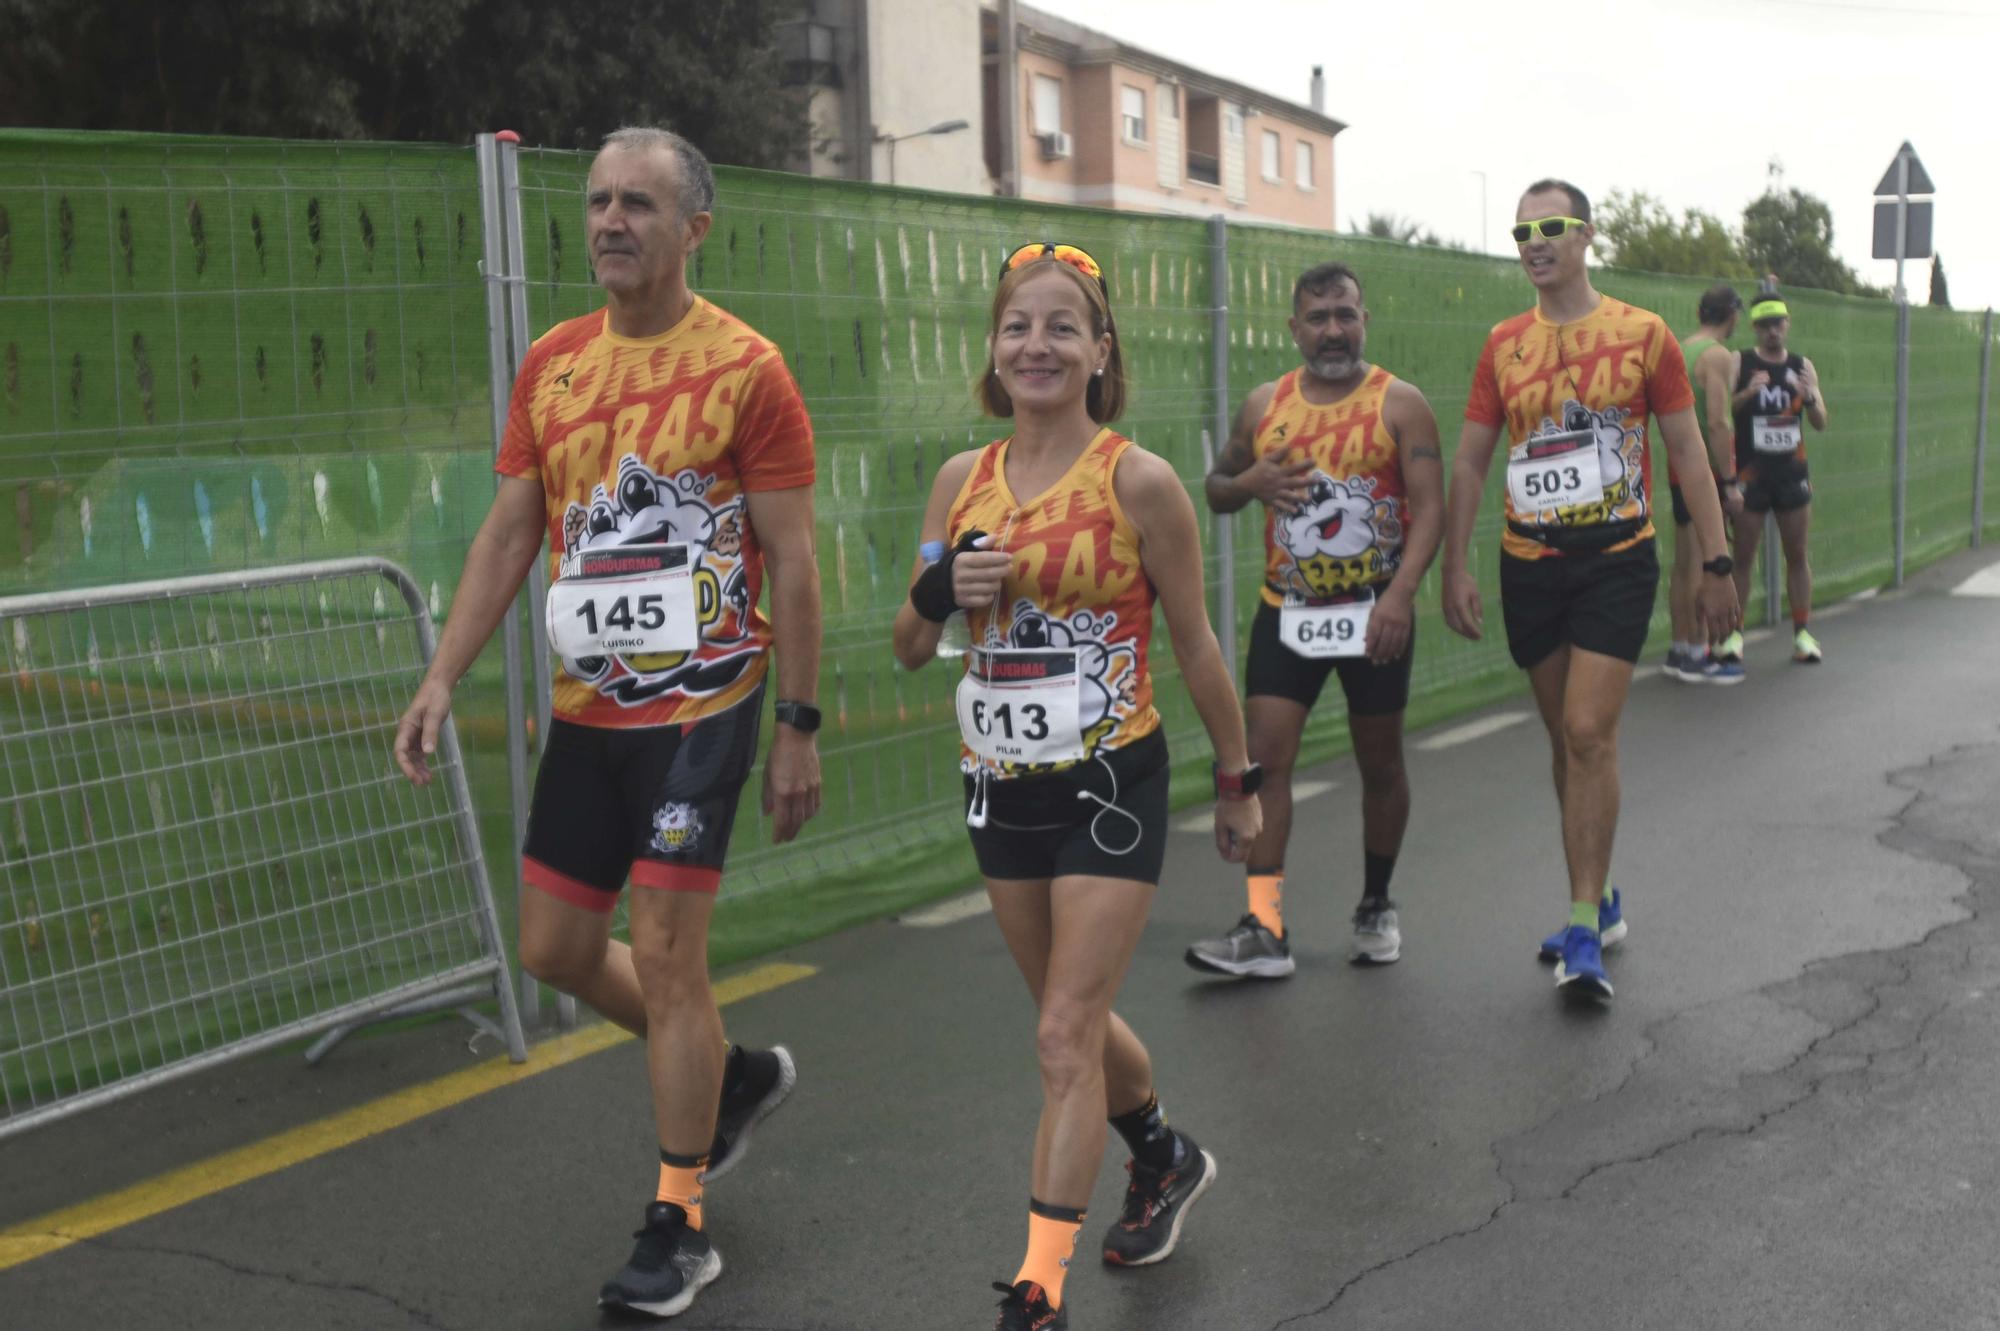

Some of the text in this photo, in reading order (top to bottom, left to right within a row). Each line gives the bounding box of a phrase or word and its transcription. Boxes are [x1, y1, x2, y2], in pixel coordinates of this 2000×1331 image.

[1525, 466, 1581, 497] 503
[576, 594, 666, 635] 145
[602, 637, 644, 649] LUISIKO
[1297, 617, 1354, 643] 649
[972, 699, 1049, 740] 613
[996, 745, 1022, 756] PILAR
